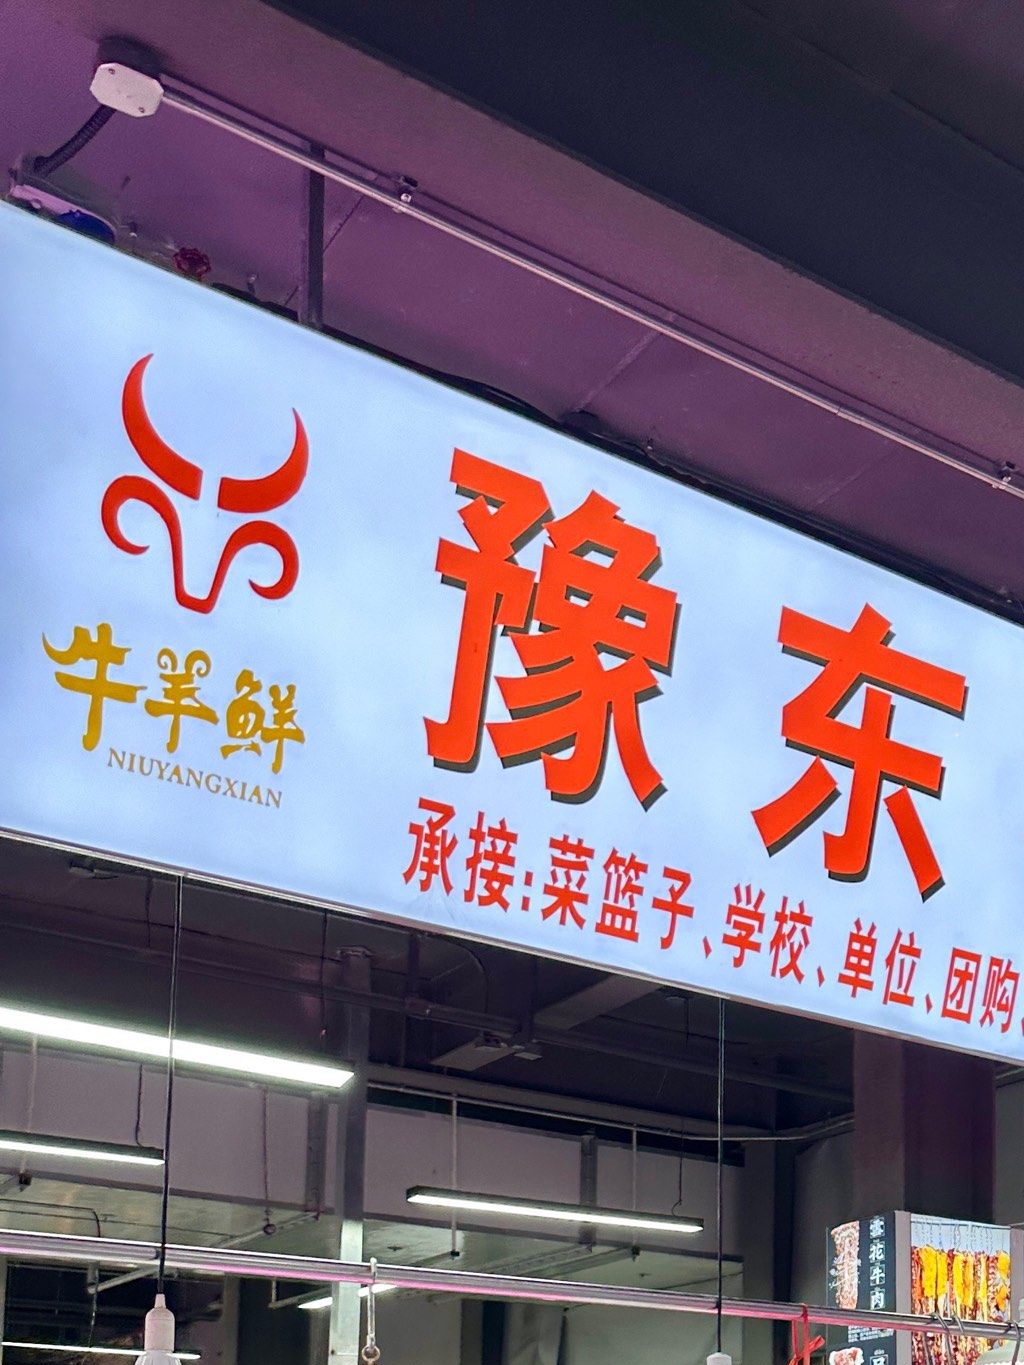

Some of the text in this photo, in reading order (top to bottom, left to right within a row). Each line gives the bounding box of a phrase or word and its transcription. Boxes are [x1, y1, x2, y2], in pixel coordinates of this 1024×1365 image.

[42, 622, 305, 774] 牛羊鲜
[107, 746, 283, 808] NIUYANGXIAN
